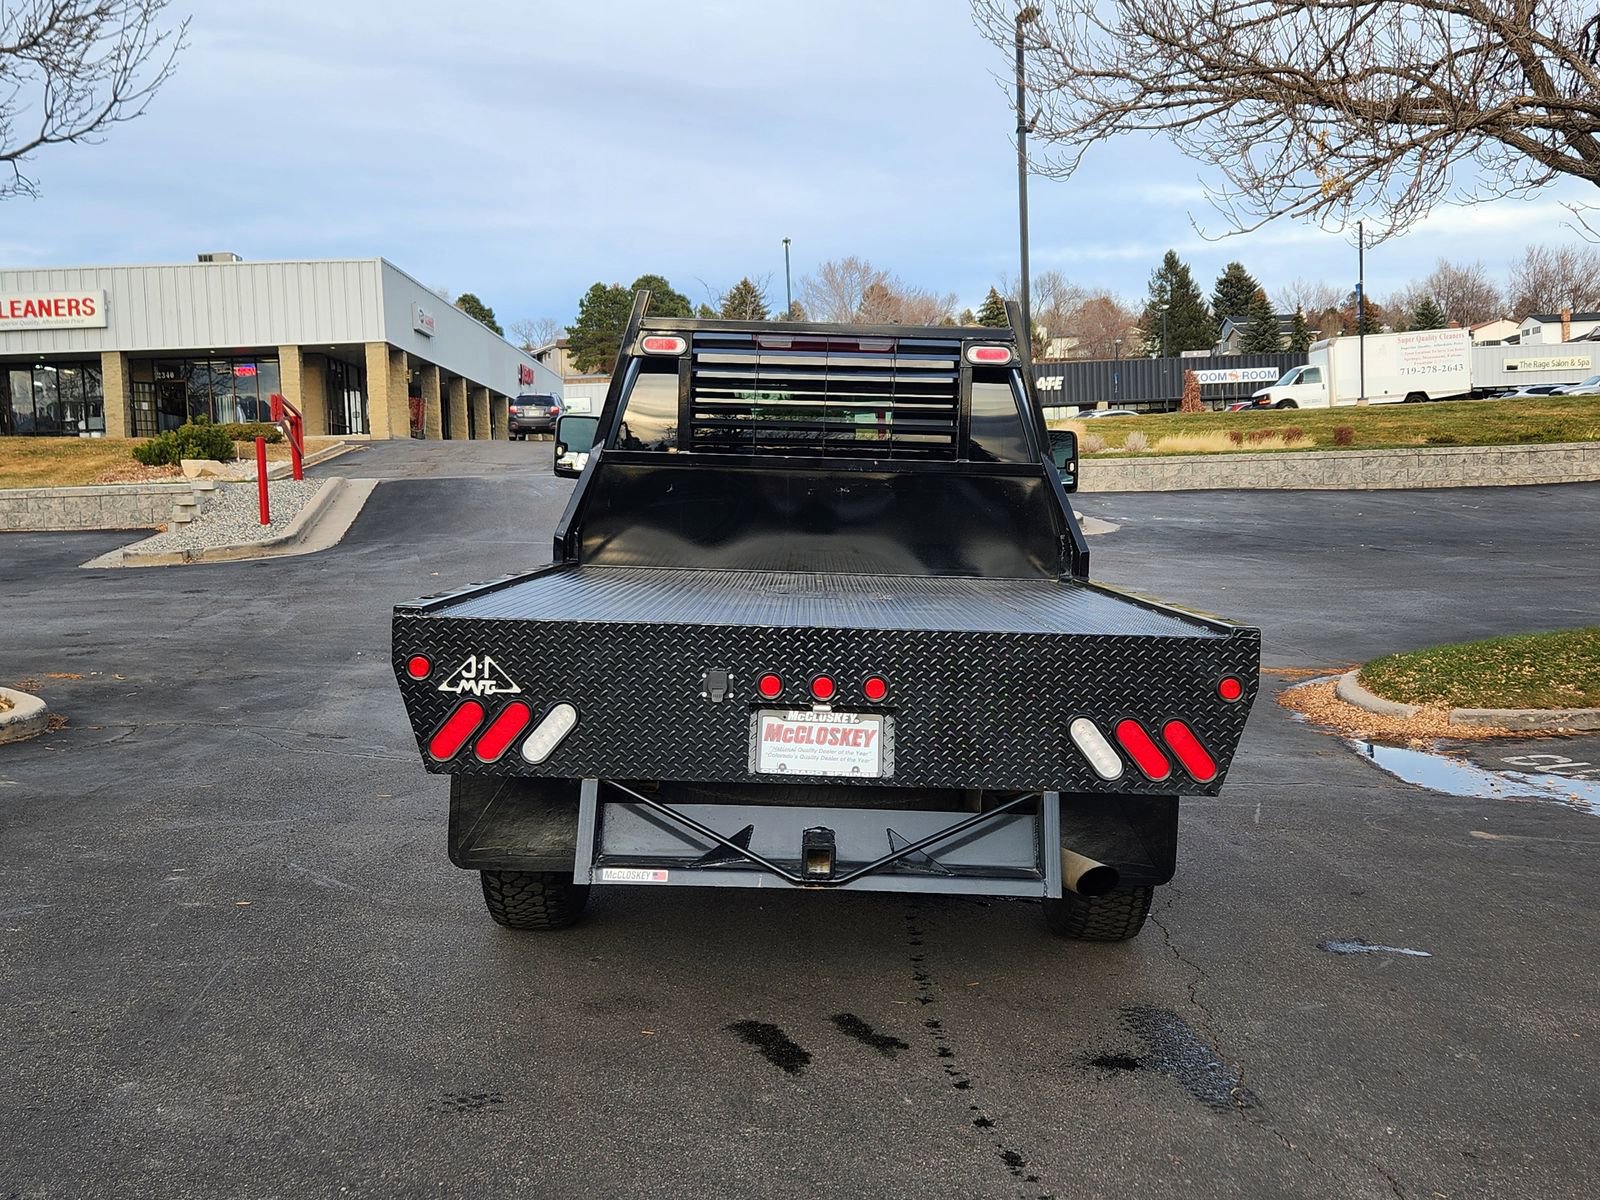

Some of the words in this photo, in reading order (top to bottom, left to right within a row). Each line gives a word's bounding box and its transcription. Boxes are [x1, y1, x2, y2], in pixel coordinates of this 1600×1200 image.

[1520, 360, 1532, 369] The
[1534, 360, 1550, 369] Rage
[1552, 359, 1569, 368] Salon
[1570, 358, 1576, 366] &
[1577, 358, 1590, 367] Spa
[1242, 370, 1277, 380] ROOM
[1400, 363, 1464, 376] 719-278-2643
[763, 723, 877, 748] McCLOSKEY
[605, 870, 651, 880] McCLOSKEY
